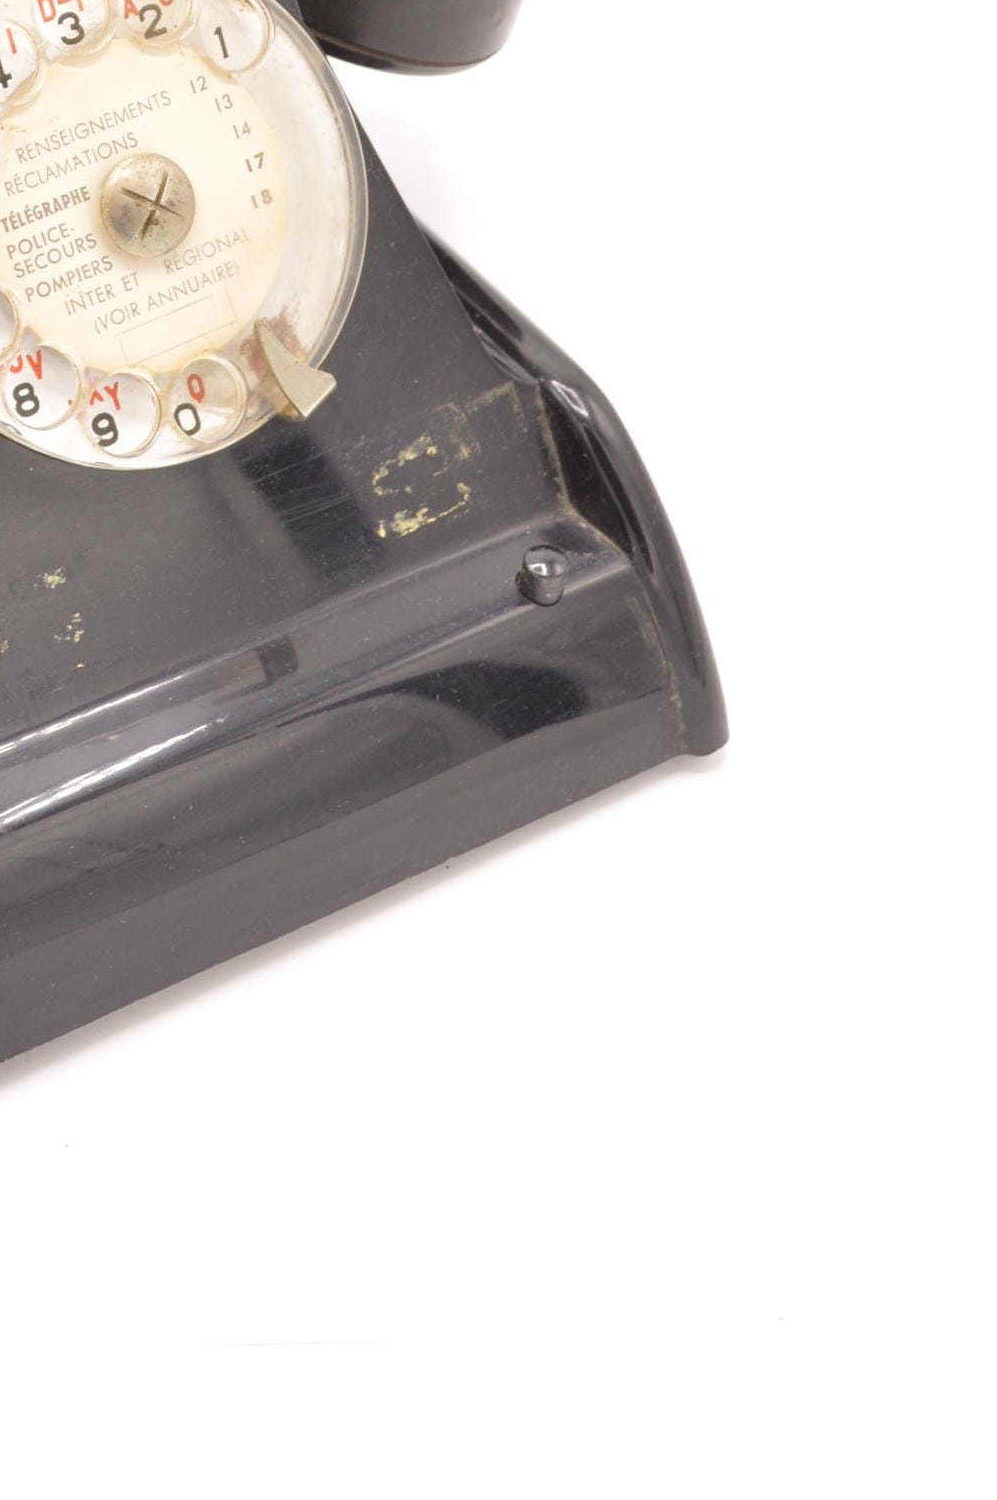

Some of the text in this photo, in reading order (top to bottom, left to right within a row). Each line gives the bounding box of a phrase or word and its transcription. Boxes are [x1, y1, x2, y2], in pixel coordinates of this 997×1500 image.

[57, 11, 85, 45] 3
[138, 3, 168, 39] 2
[213, 26, 229, 59] 1
[15, 75, 208, 164] RENSEIGNEMENTS 12
[3, 93, 233, 197] RÉCLAMATIONS 13
[0, 120, 251, 234] TÉLÉGRAPHE 14
[13, 151, 264, 279] SECOURS 17
[5, 222, 75, 261] POLICE-
[24, 188, 273, 303] POMPIERS 18
[65, 282, 116, 316] INTER
[121, 271, 140, 293] ET
[94, 301, 141, 335] (VOIR
[12, 382, 40, 417] 8
[91, 412, 119, 447] 9
[173, 402, 201, 436] 0
